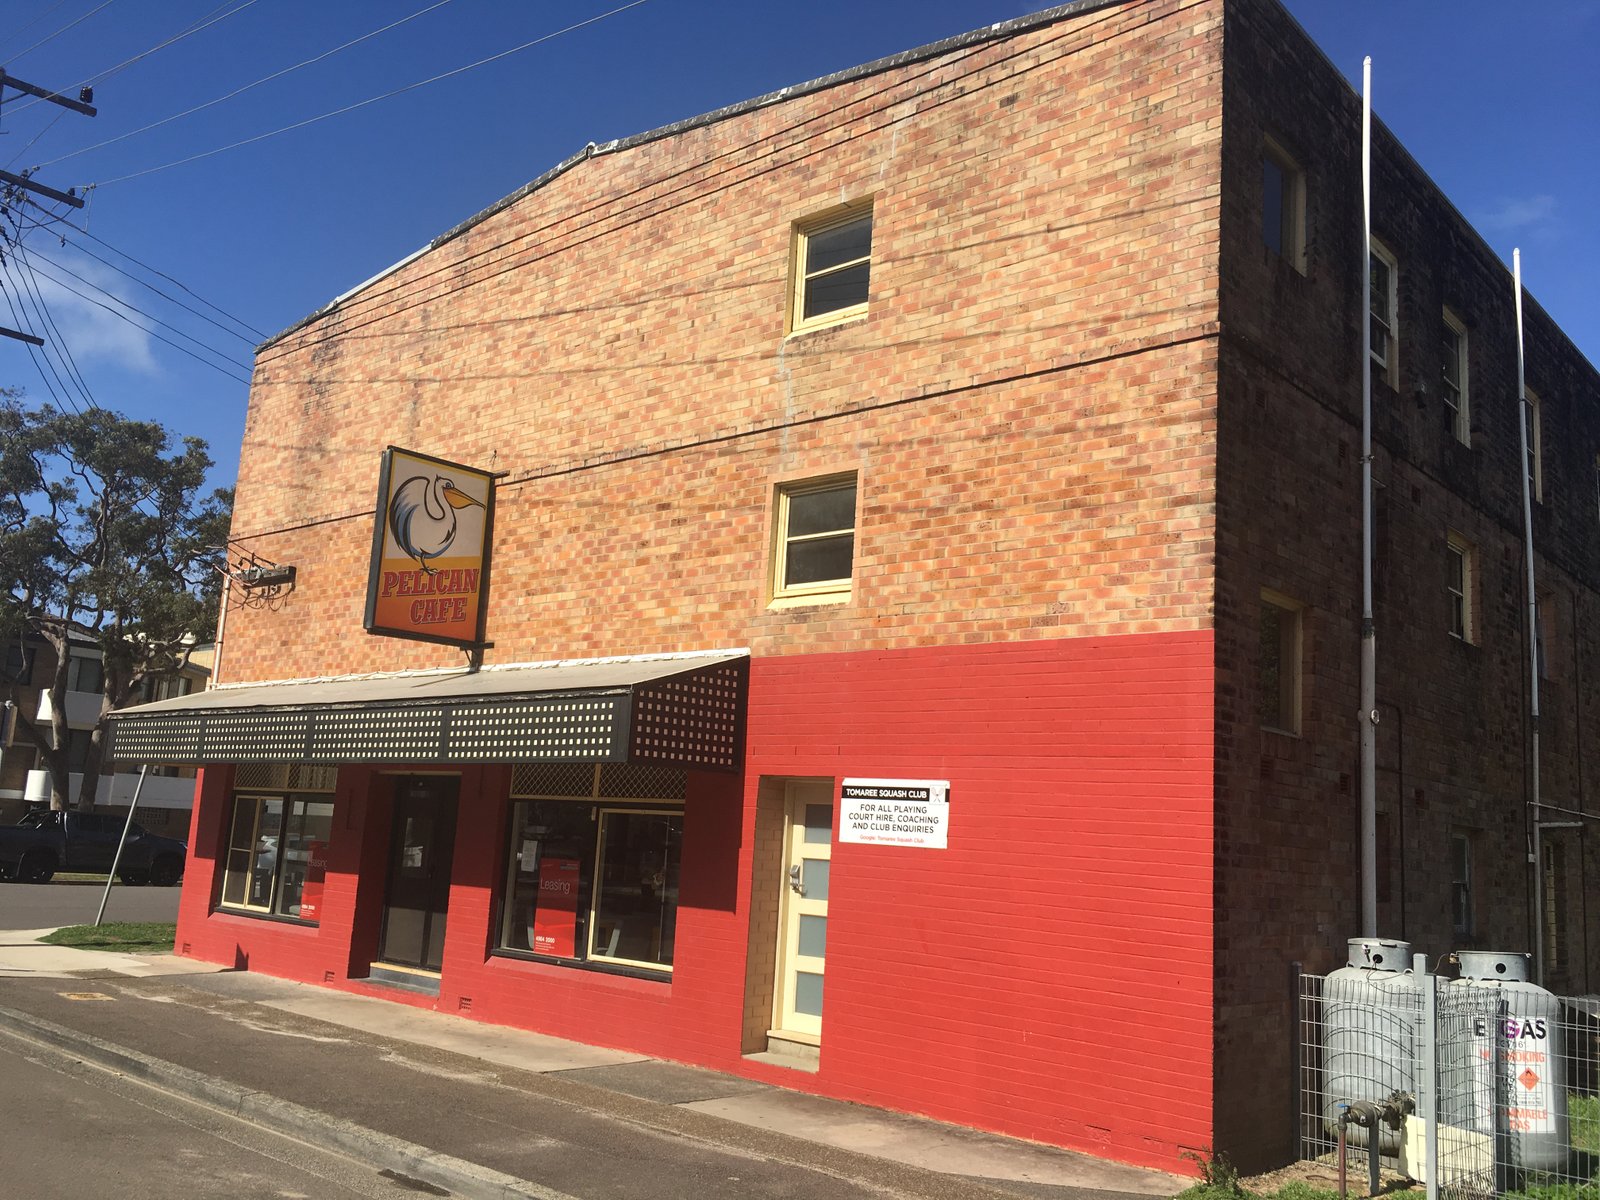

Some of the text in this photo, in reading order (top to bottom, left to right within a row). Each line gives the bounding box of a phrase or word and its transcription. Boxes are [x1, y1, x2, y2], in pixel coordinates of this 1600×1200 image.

[381, 569, 479, 597] PELICAN
[410, 597, 467, 625] CAFE
[846, 788, 927, 799] TOMAREE SQUASH CLUB
[860, 804, 928, 814] FOR ALL PLAYING
[849, 813, 939, 824] COURT HIRE, COACHING
[852, 822, 934, 834] AND CLUB ENQUIRIES
[540, 880, 570, 894] Leasing
